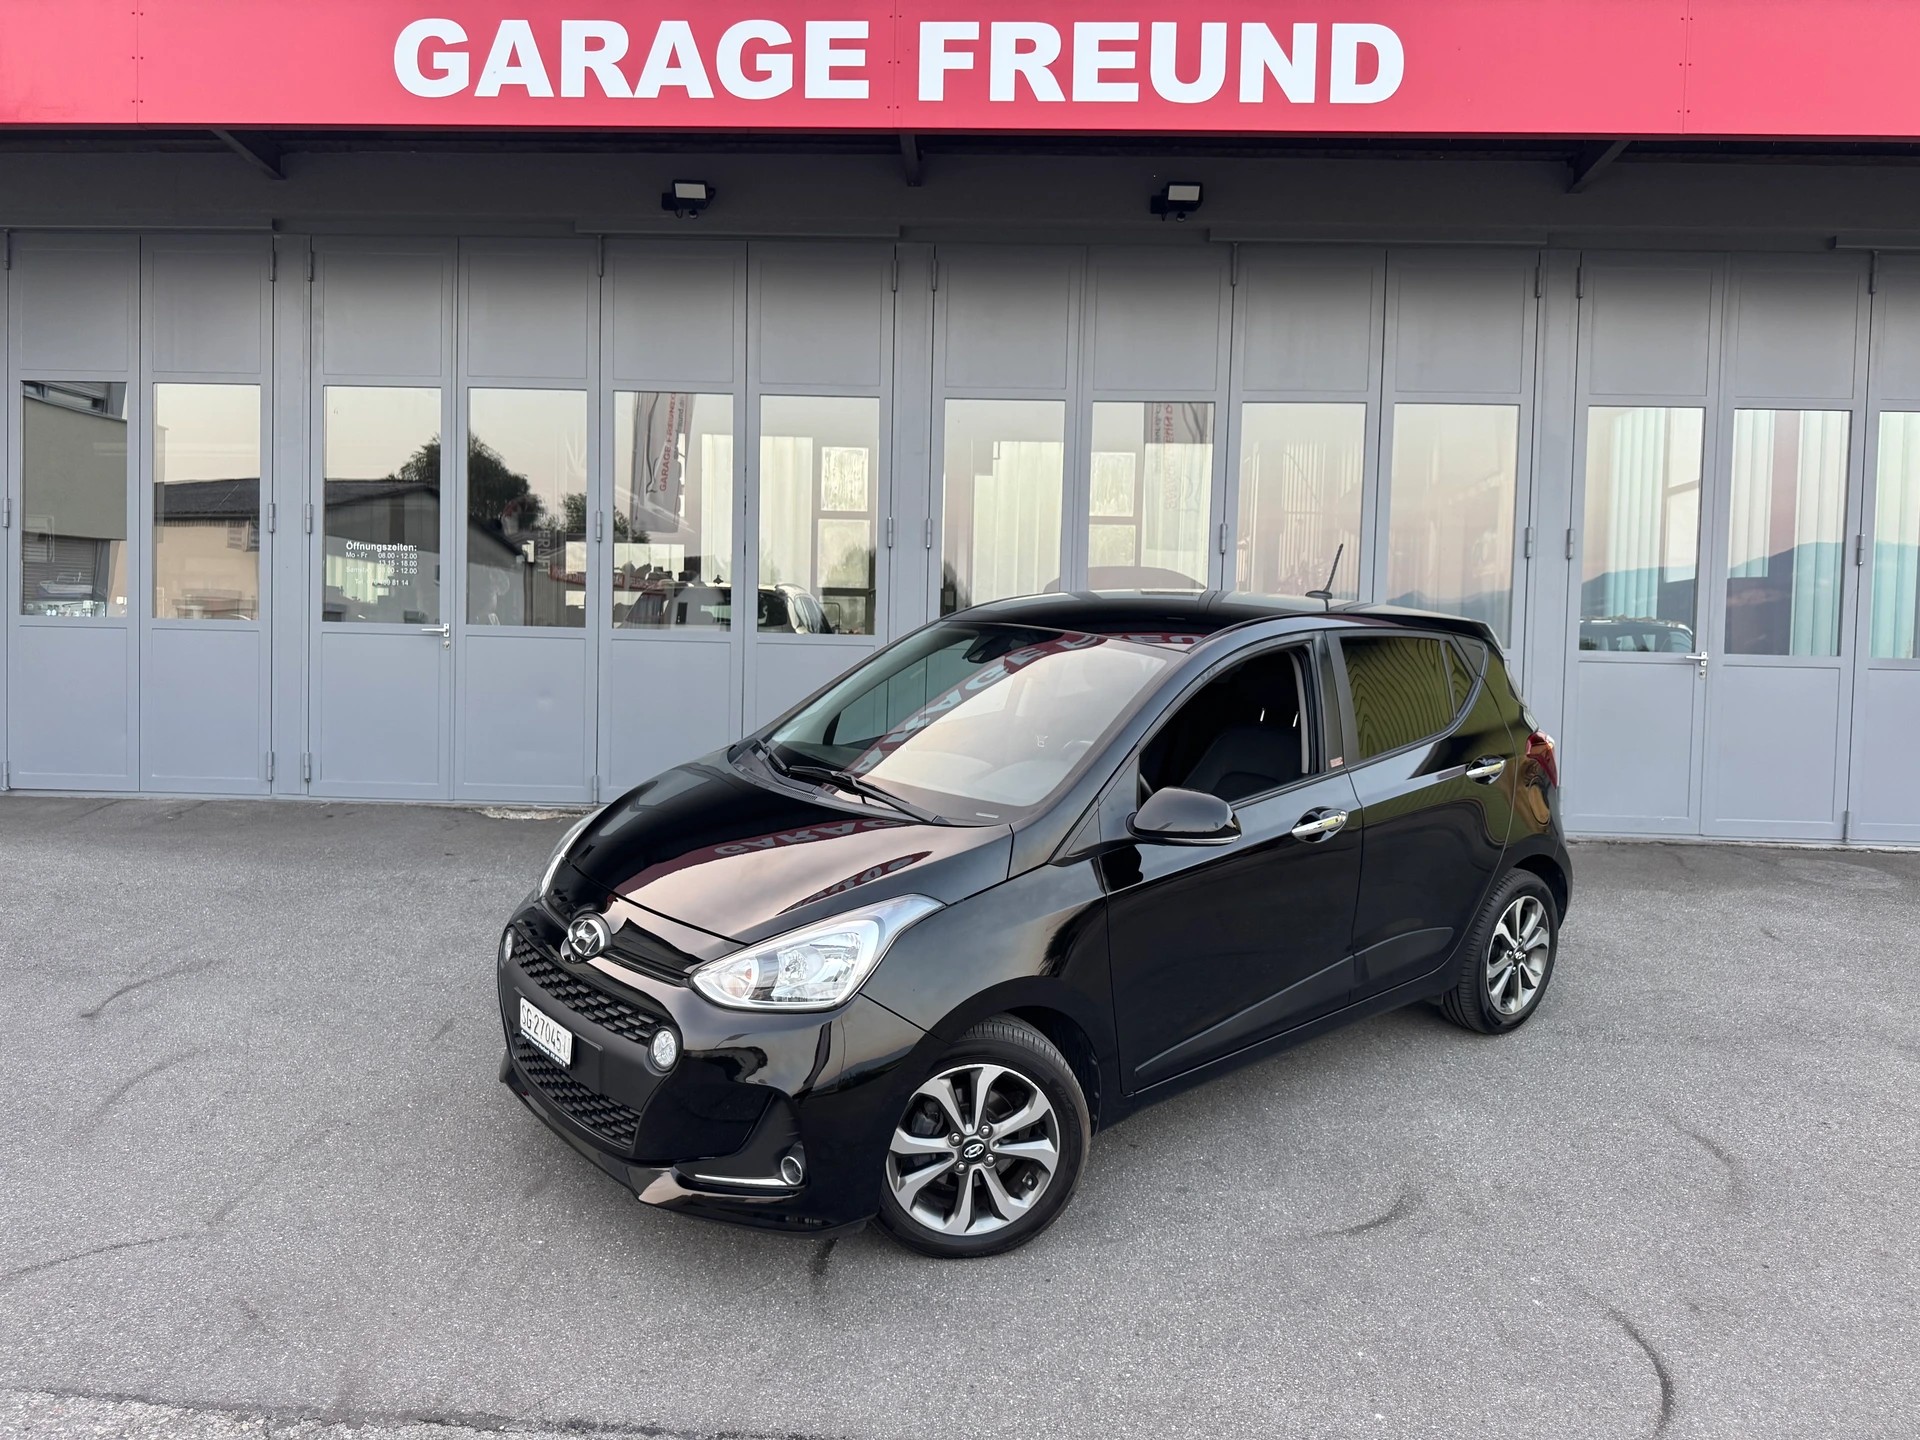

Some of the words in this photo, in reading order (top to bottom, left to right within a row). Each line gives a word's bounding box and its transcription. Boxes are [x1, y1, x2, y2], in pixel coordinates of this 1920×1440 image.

[393, 18, 869, 100] GARAGE
[918, 21, 1405, 104] FREUND
[659, 446, 671, 491] GARAGE
[346, 540, 417, 552] Öffnungszeiten:
[522, 1004, 532, 1029] SG
[534, 1014, 562, 1054] 27045
